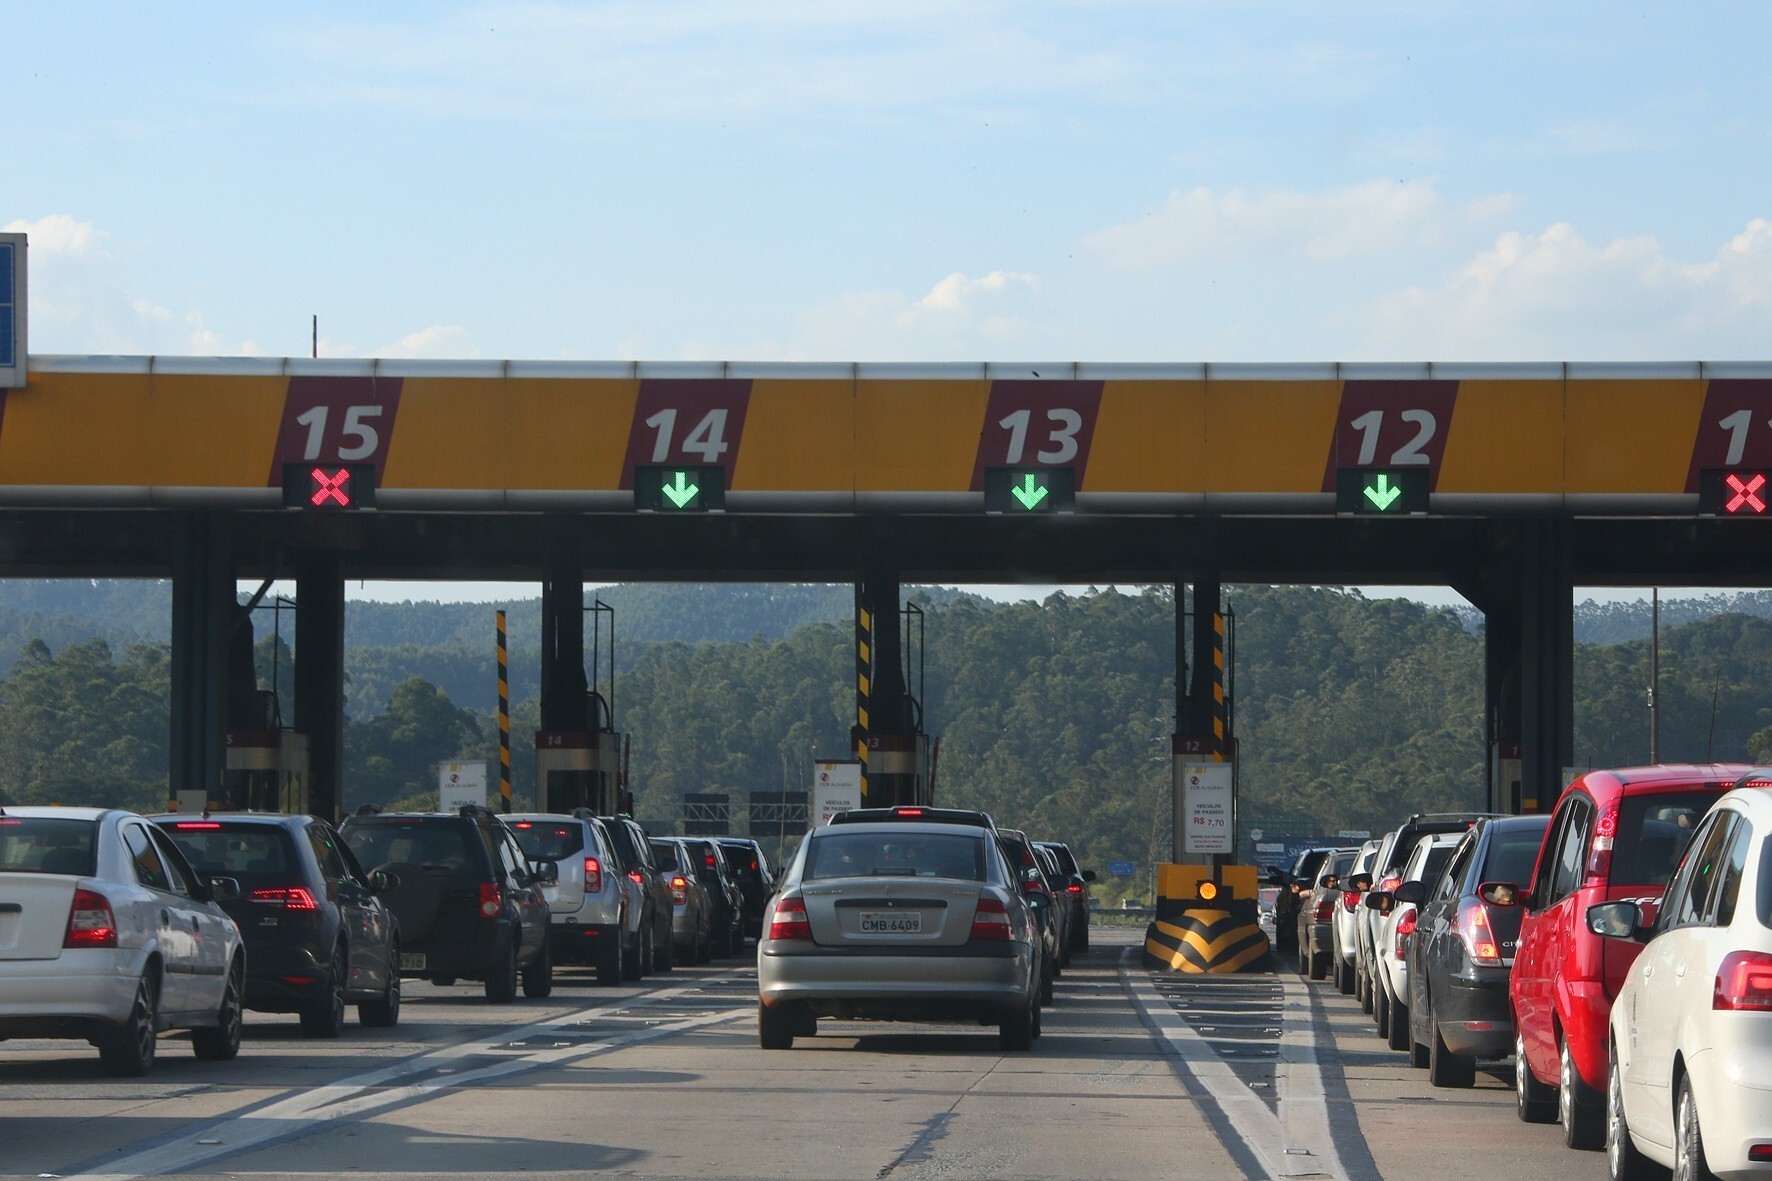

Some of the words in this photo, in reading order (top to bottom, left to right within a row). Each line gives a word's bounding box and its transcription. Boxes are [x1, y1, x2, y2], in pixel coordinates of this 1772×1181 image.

[296, 405, 383, 461] 15
[645, 408, 729, 463] 14
[998, 408, 1083, 465] 13
[1350, 409, 1437, 466] 12
[1718, 409, 1772, 466] 1
[547, 735, 562, 746] 14
[1185, 740, 1200, 751] 12
[1193, 817, 1205, 825] R$
[1207, 819, 1225, 827] 7,70
